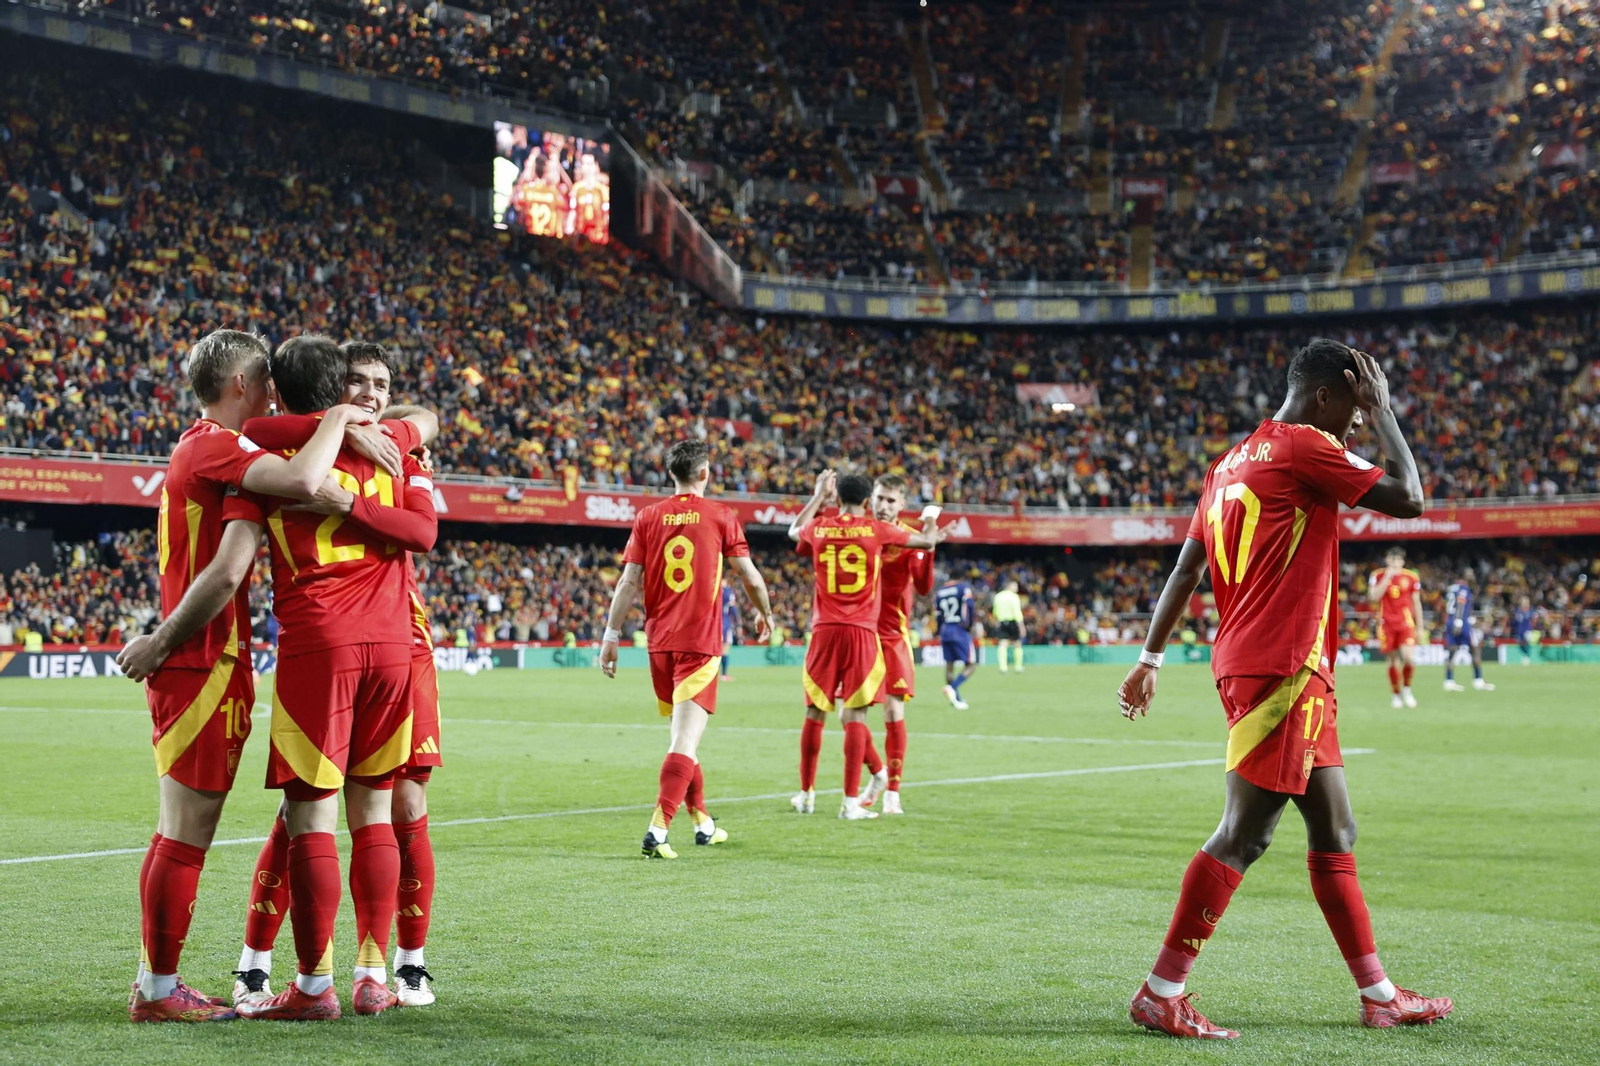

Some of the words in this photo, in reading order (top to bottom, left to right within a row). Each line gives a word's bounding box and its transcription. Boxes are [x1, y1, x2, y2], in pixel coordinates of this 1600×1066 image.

[1250, 442, 1273, 462] JR.
[0, 464, 34, 479] CIÓN
[36, 468, 104, 482] ESPAÑOLA
[20, 479, 70, 493] FÚTBOL
[663, 509, 700, 526] FABIÁN
[1207, 482, 1261, 586] 17
[664, 535, 695, 593] 8
[819, 544, 867, 594] 19
[939, 596, 961, 623] 12
[28, 654, 98, 679] UEFA
[220, 697, 250, 739] 10
[1302, 696, 1325, 741] 17
